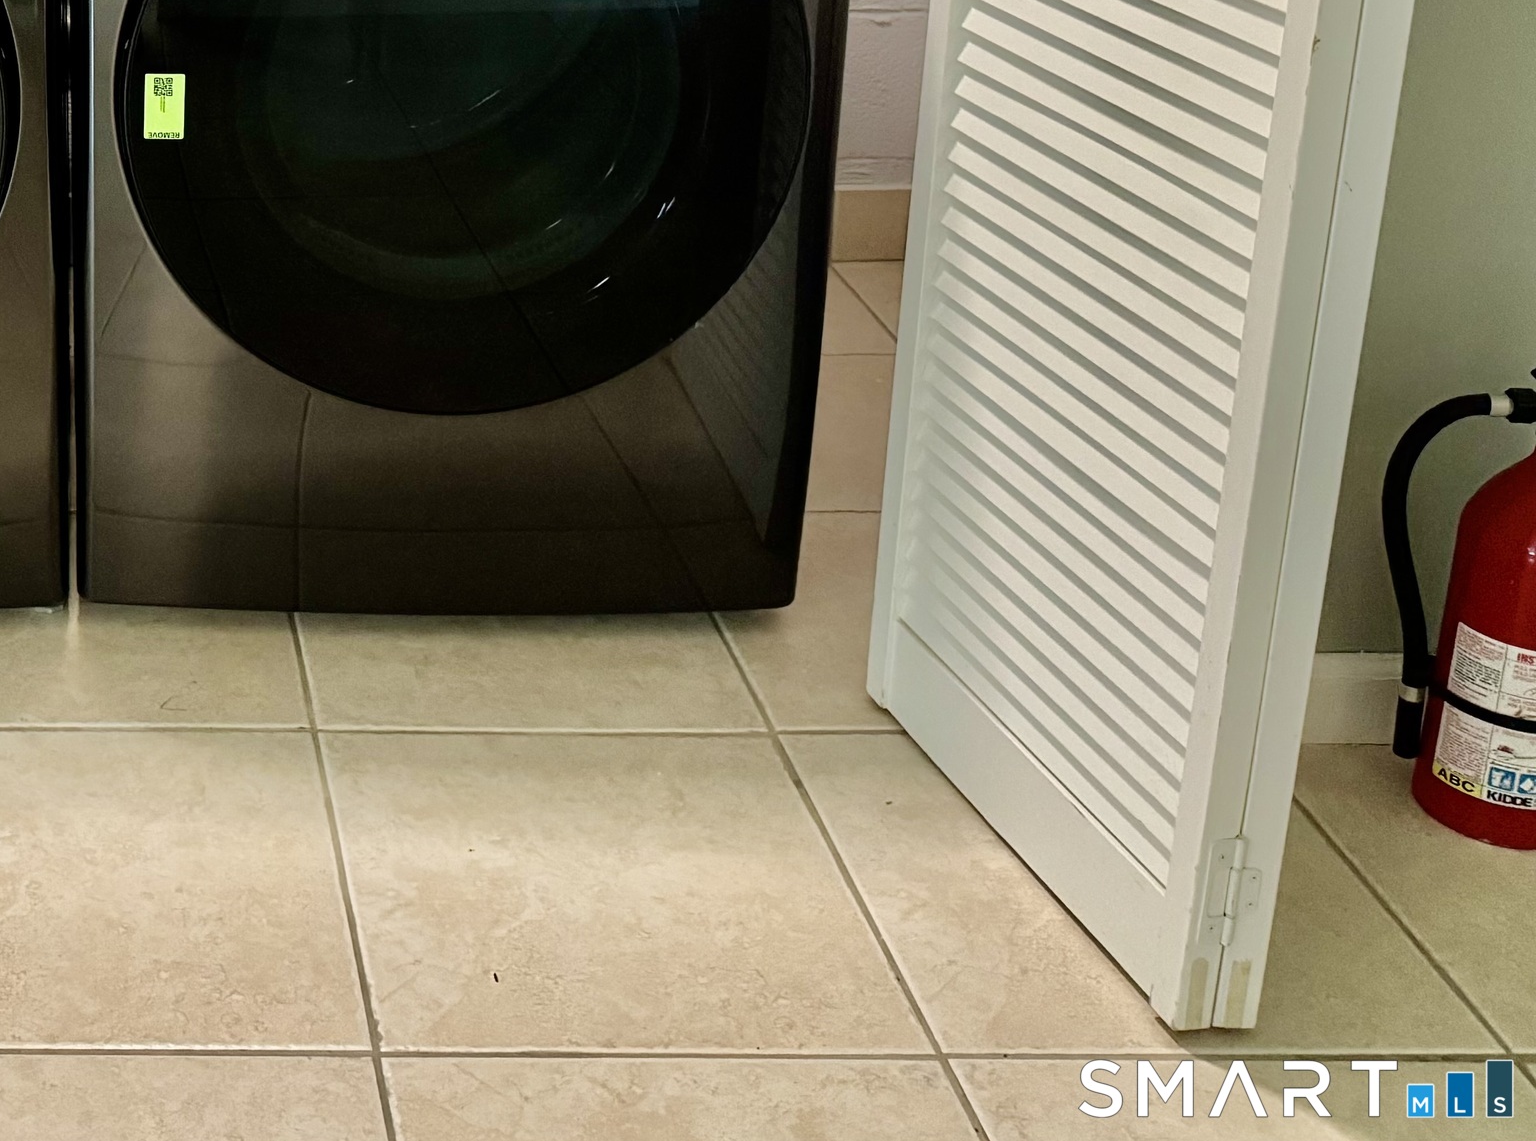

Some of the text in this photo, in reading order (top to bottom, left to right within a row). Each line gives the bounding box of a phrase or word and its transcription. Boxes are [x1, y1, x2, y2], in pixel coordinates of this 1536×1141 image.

[147, 131, 180, 139] REMOVE
[1437, 767, 1475, 793] ABC
[1486, 790, 1533, 808] KIDDE
